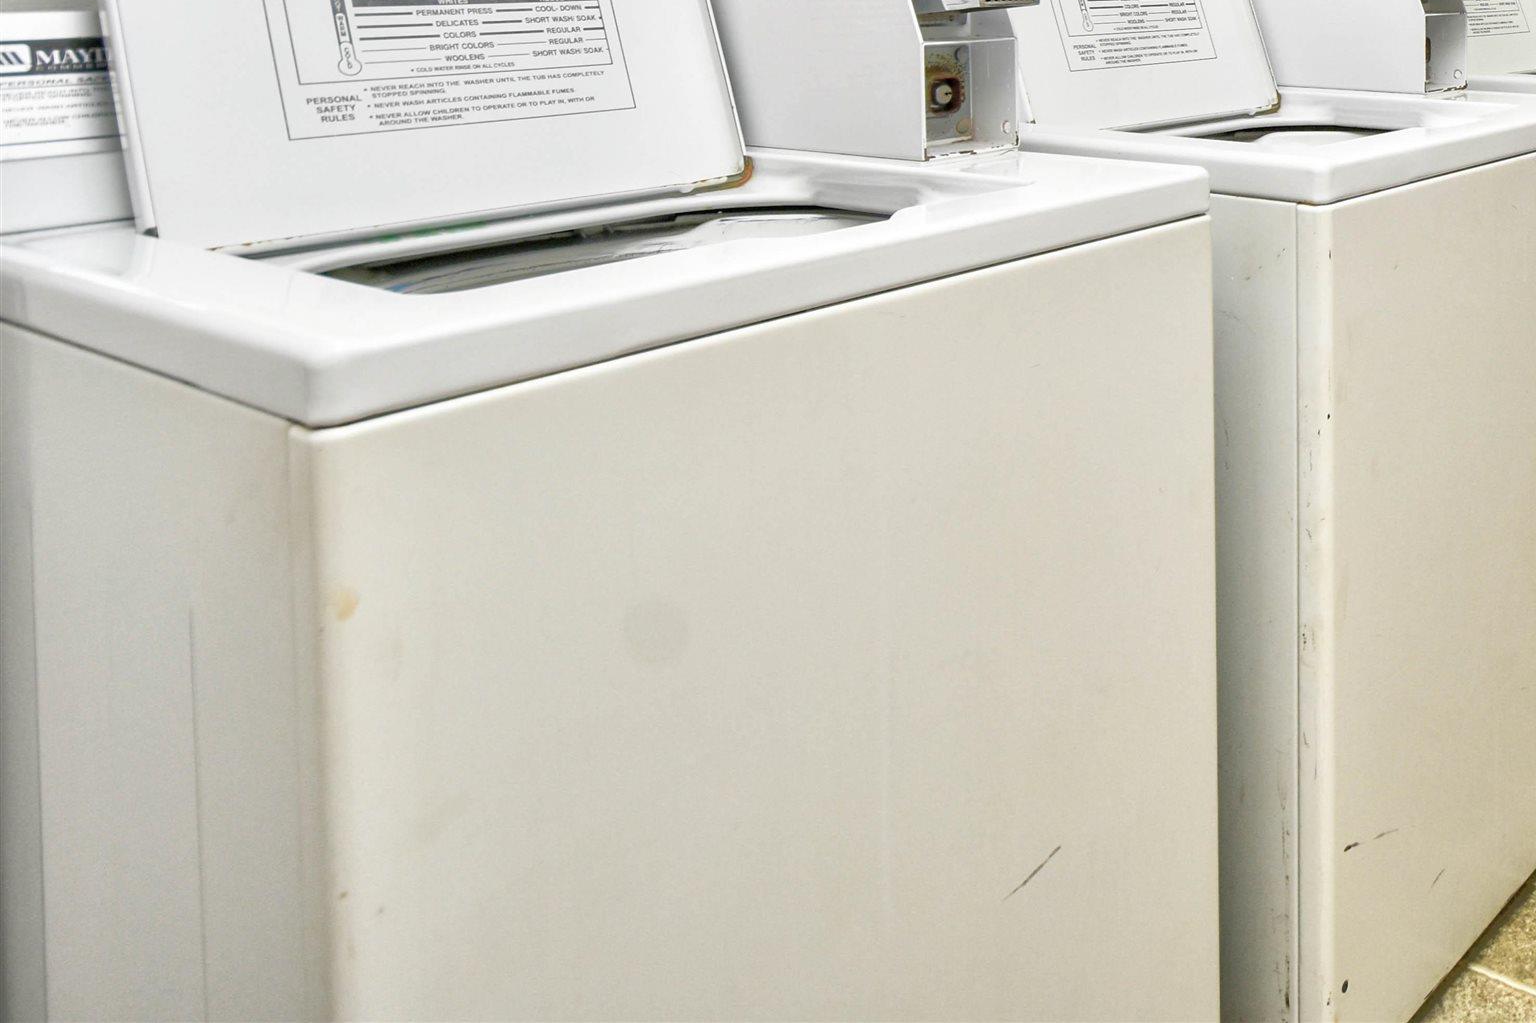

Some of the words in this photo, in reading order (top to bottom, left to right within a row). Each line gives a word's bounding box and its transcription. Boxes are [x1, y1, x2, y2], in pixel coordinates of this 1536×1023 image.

[466, 7, 493, 15] PRESS
[435, 19, 479, 27] DELICATES
[524, 16, 550, 24] SHORT
[546, 26, 582, 34] REGULAR
[443, 31, 477, 39] COLORS
[549, 37, 584, 45] REGULAR
[429, 43, 459, 51] BRIGHT
[461, 41, 495, 50] COLORS
[445, 53, 486, 62] WOOLENS
[532, 49, 557, 57] SHORT
[463, 78, 495, 86] WASHER
[562, 70, 605, 79] COMPLETELY
[371, 91, 408, 99] STOPPED
[426, 97, 462, 105] ARTICLES
[463, 92, 507, 102] CONTAINING
[508, 89, 550, 98] FLAMMABLE
[306, 95, 363, 106] PERSONAL
[316, 104, 356, 114] SAFETY
[375, 112, 402, 120] NEVER
[403, 110, 431, 118] ALLOW
[432, 107, 470, 115] CHILDREN
[482, 102, 516, 111] OPERATE
[320, 113, 356, 123] RULES
[379, 118, 413, 126] AROUND
[414, 116, 429, 124] THE
